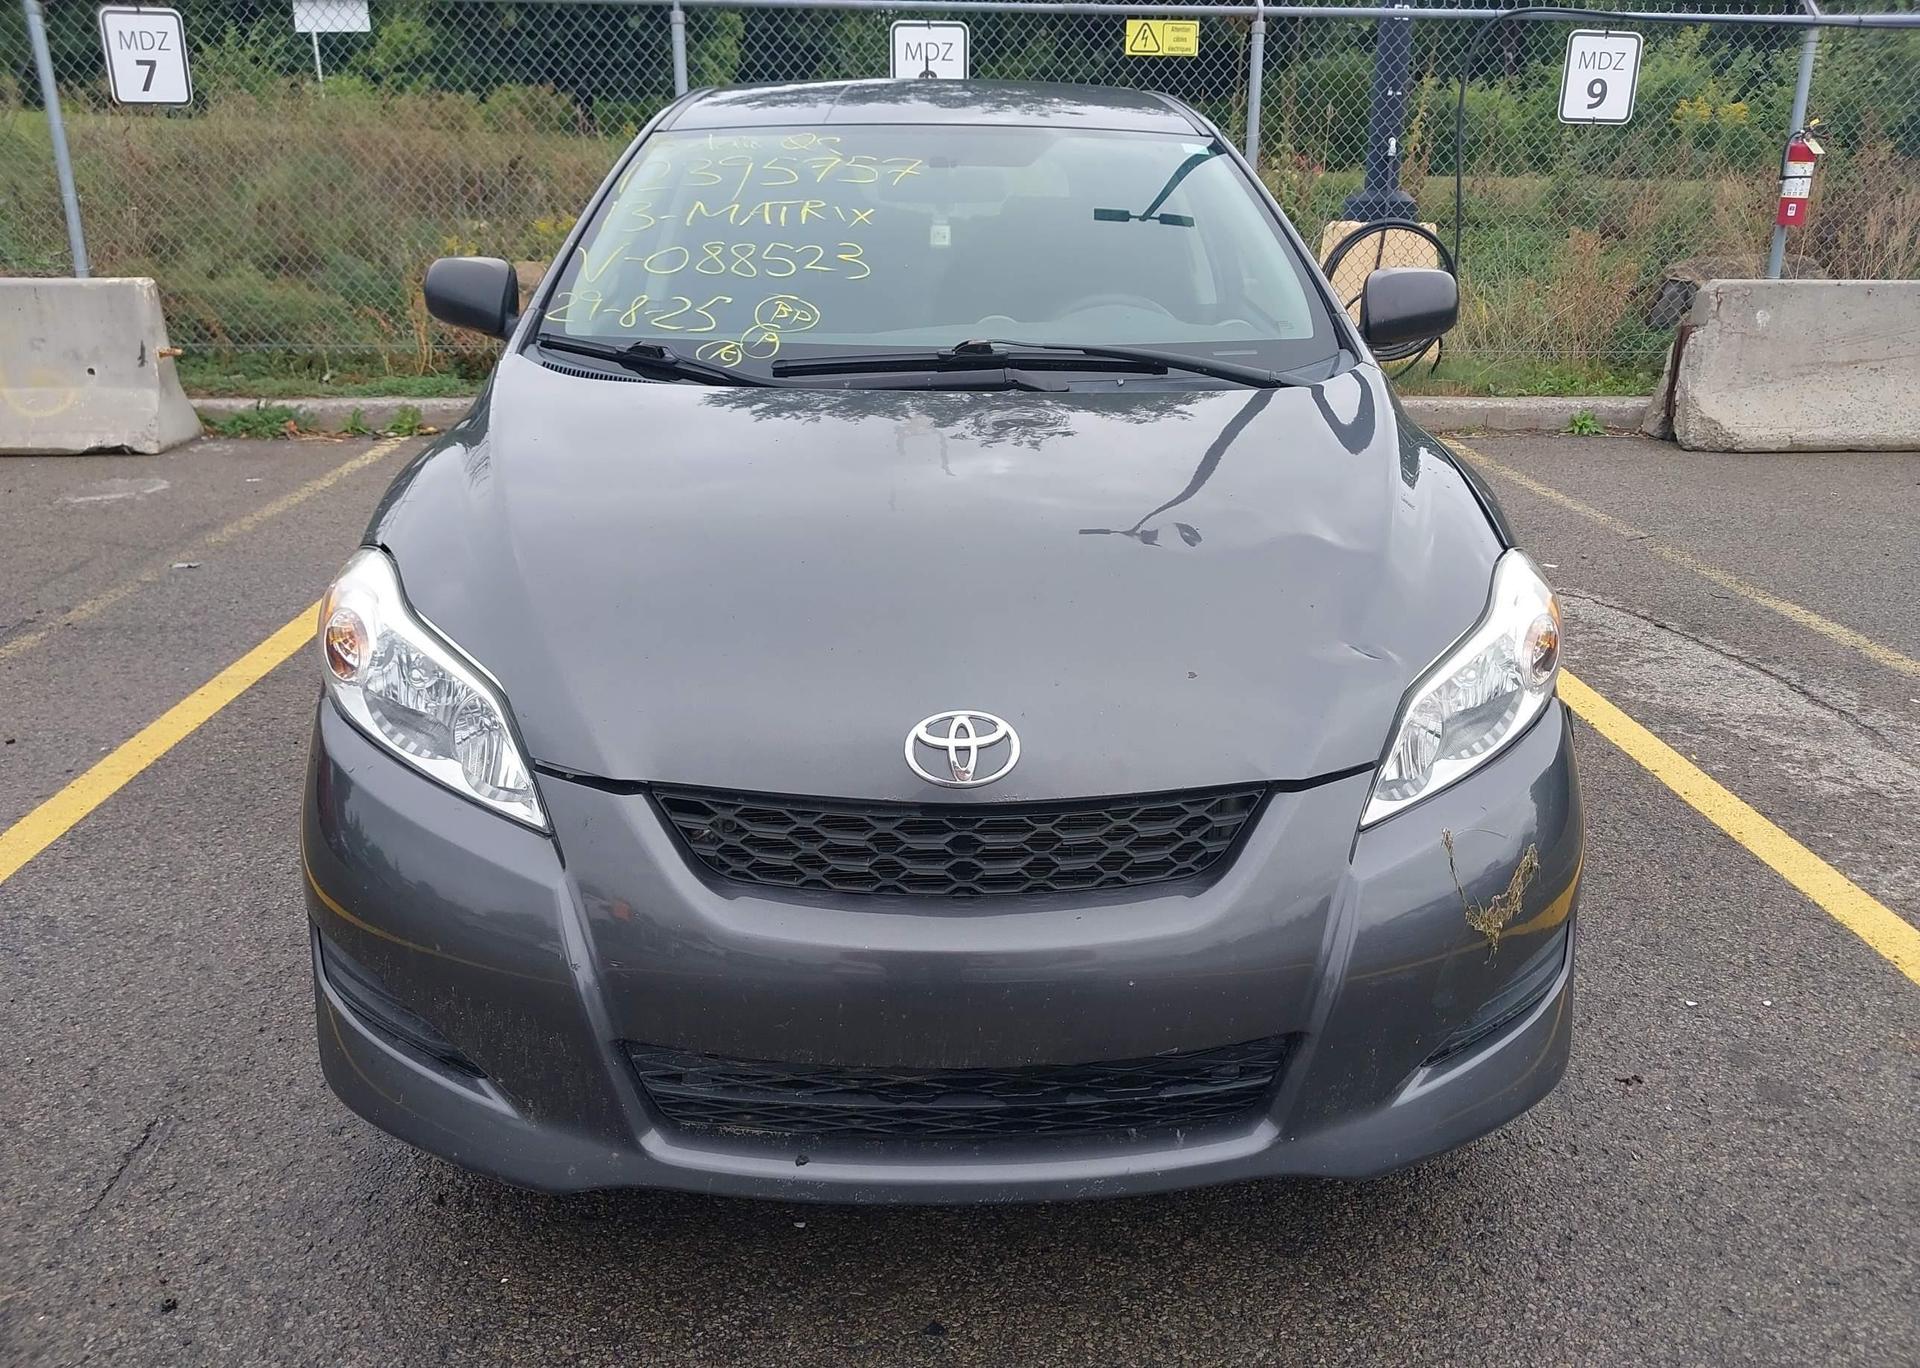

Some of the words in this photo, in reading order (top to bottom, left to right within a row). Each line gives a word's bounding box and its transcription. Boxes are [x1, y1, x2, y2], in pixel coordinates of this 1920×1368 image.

[118, 30, 171, 50] MDZ
[904, 41, 954, 61] MDZ
[135, 59, 157, 92] 7
[1578, 50, 1627, 71] MDZ
[1586, 77, 1608, 110] 9
[618, 154, 924, 201] 12395757
[578, 241, 872, 283] V-088523
[543, 290, 733, 332] 29-8-25
